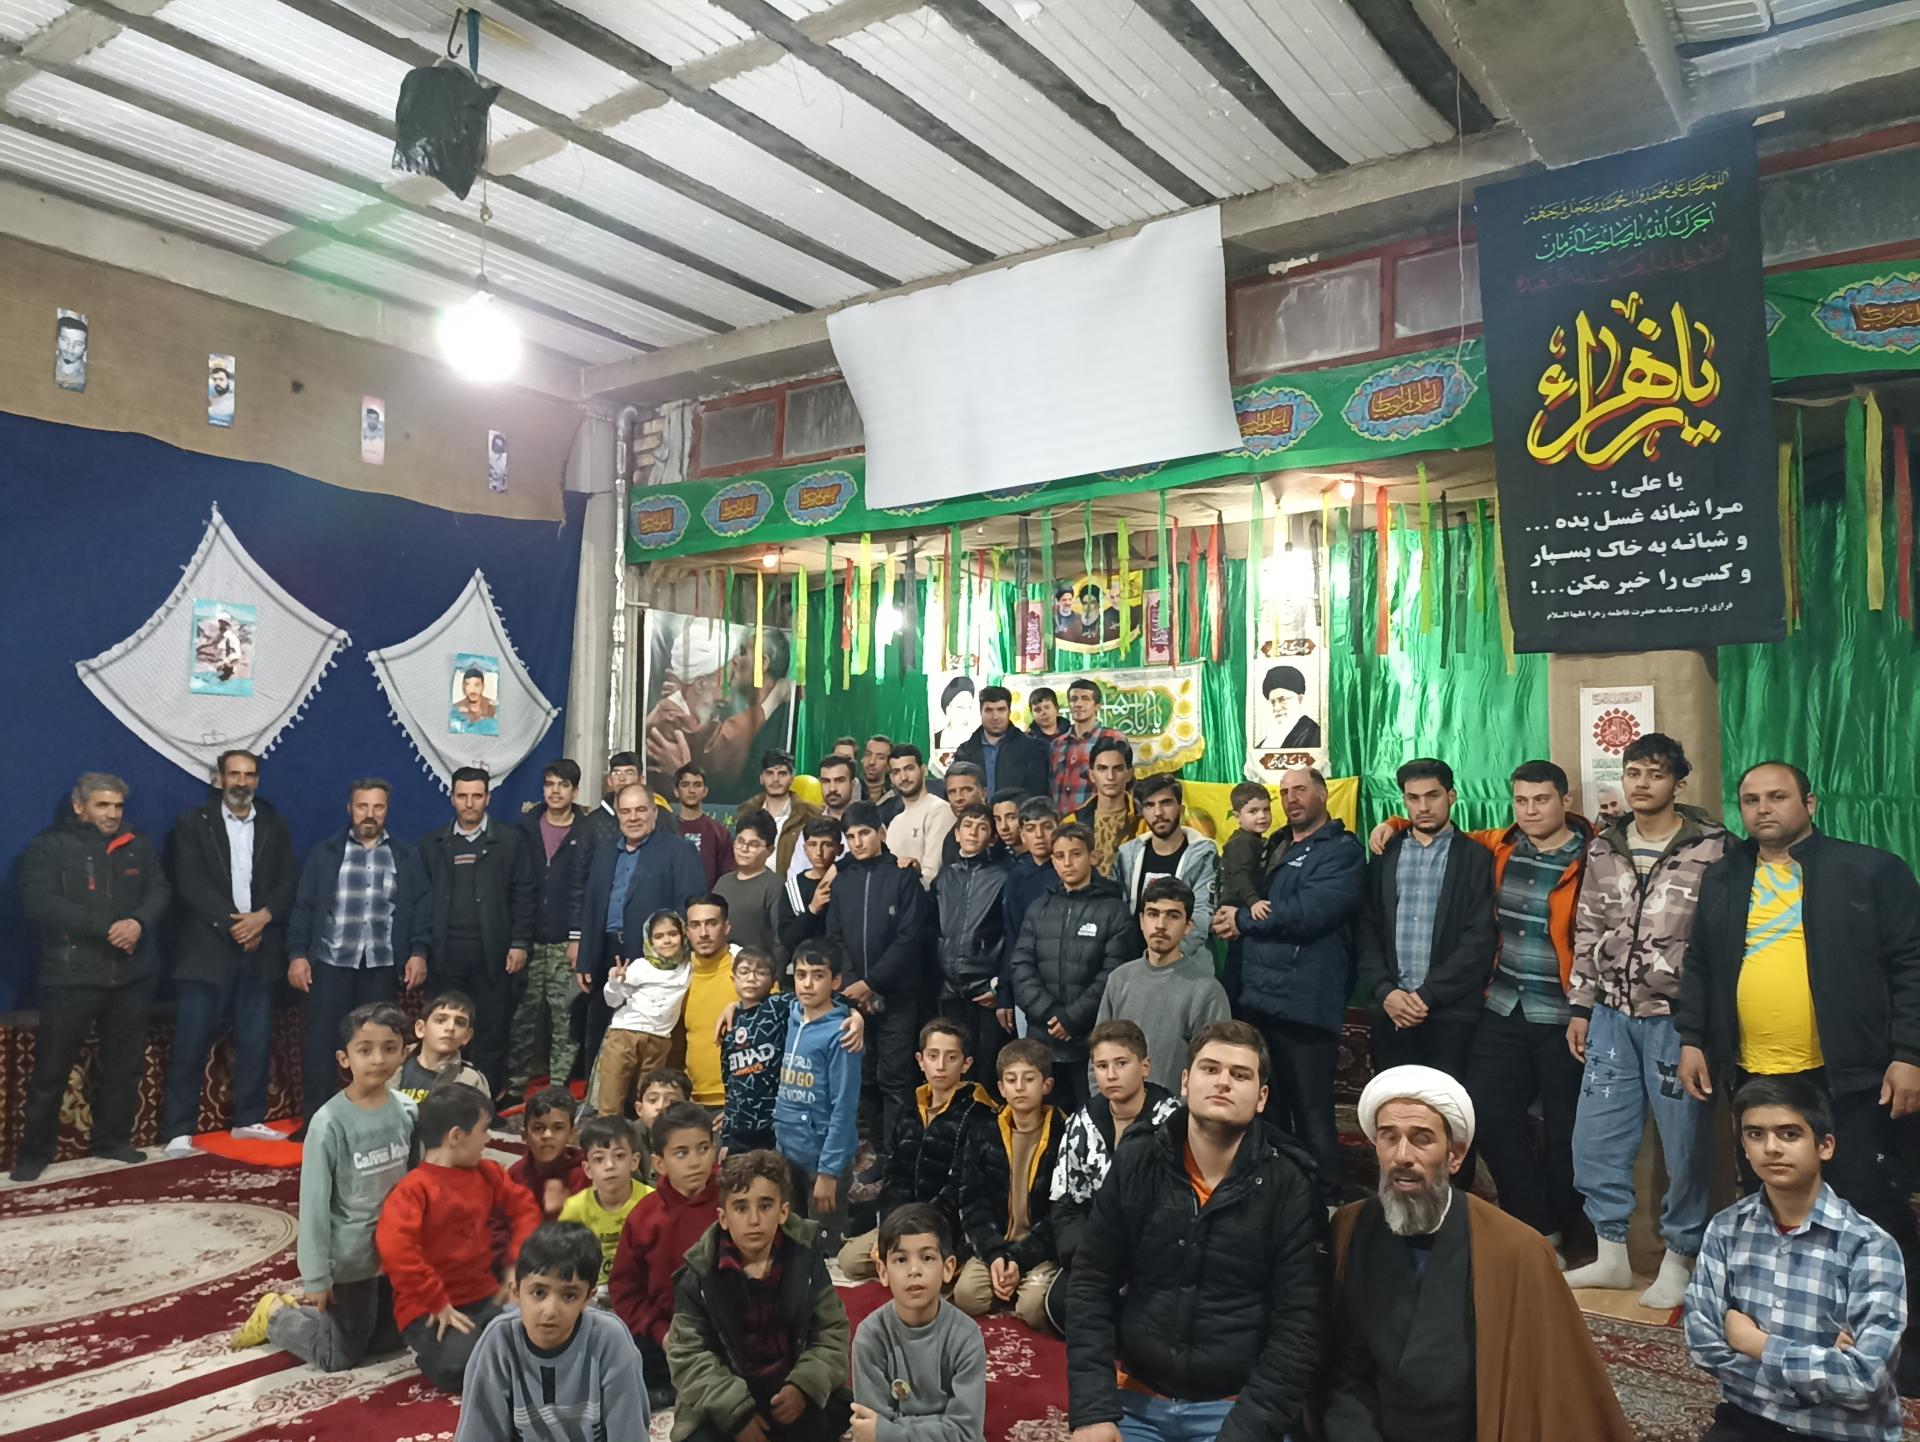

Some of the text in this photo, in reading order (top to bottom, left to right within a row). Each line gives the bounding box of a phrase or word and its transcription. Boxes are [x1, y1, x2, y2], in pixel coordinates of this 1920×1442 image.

[1668, 472, 1684, 491] یا
[1650, 500, 1700, 522] شبانه
[1705, 498, 1743, 520] مرا
[1556, 516, 1589, 531] بده
[1594, 508, 1644, 531] غسل
[1530, 530, 1748, 567] و شبانه به خاک بسپار
[1614, 570, 1650, 594] خبر
[1659, 569, 1677, 590] را
[1682, 563, 1733, 588] کسی
[1739, 568, 1752, 583] و
[1547, 611, 1569, 620] السلام
[1607, 609, 1630, 617] فاطمه
[1630, 608, 1656, 617] حضرت
[1658, 606, 1674, 614] نامه
[1675, 605, 1699, 614] وصیت
[1700, 603, 1708, 613] از
[796, 1071, 815, 1089] GO
